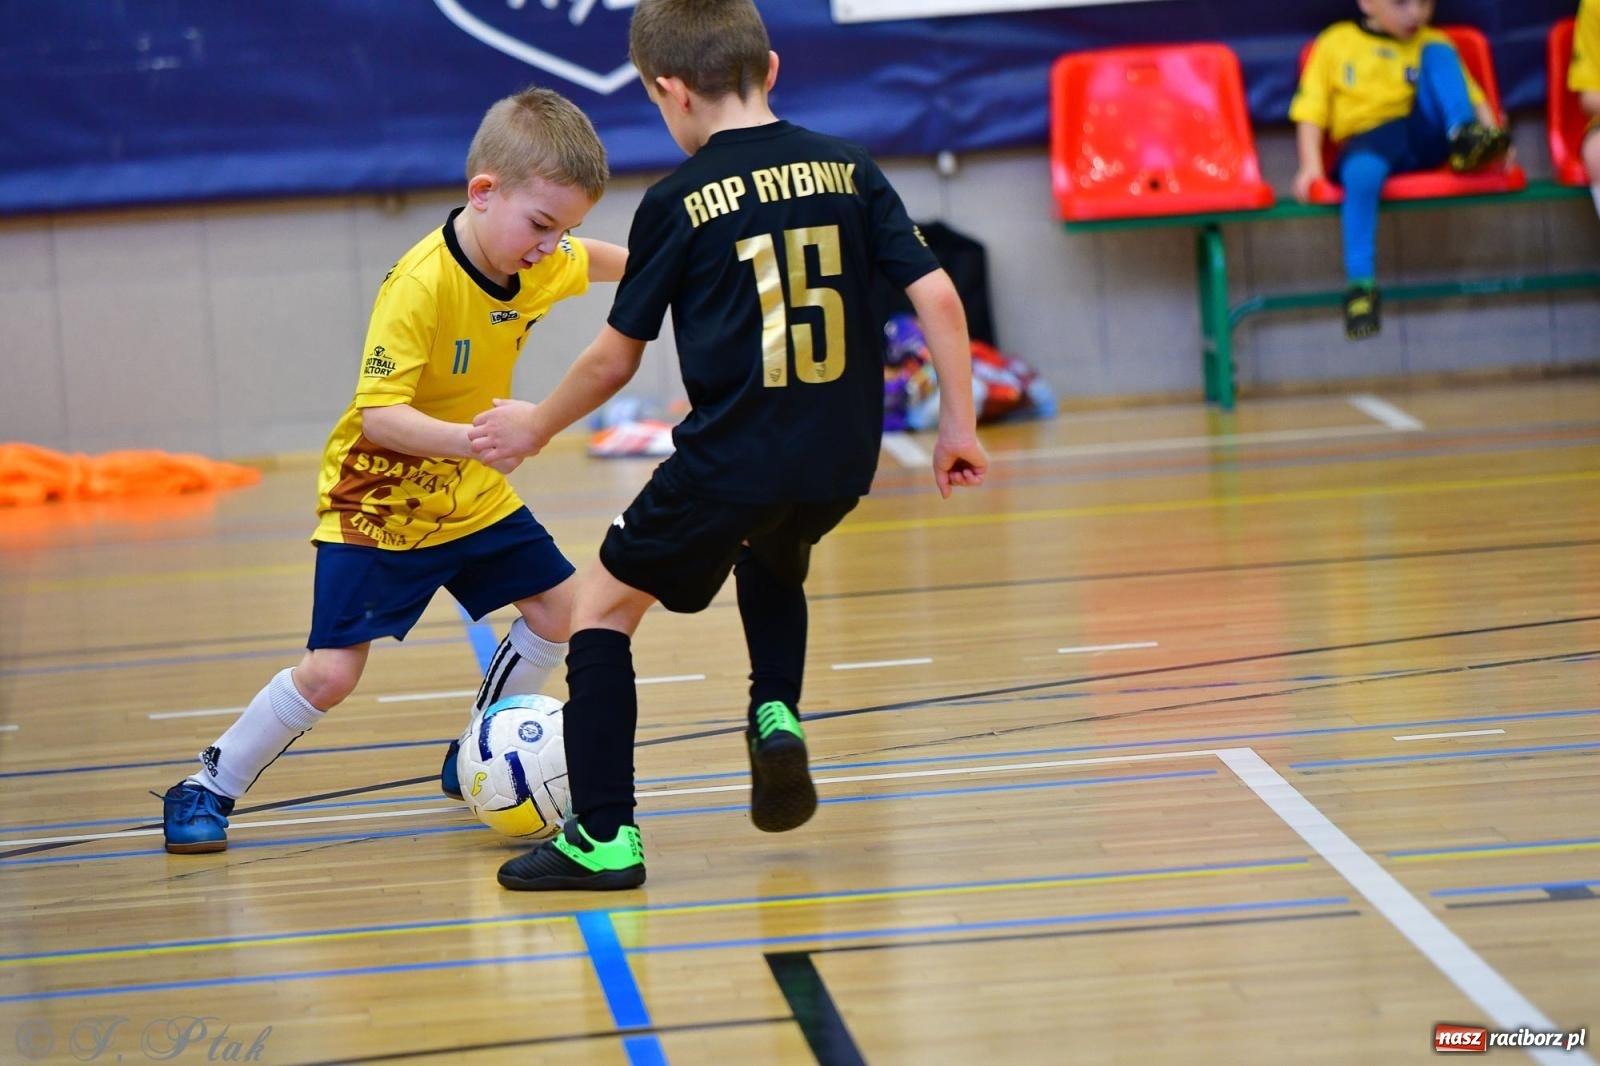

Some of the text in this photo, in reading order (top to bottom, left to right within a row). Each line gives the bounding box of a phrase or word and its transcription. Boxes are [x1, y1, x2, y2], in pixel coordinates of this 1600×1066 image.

[683, 161, 859, 228] RAP RYBNIK
[735, 224, 846, 388] 15
[452, 339, 470, 375] 11
